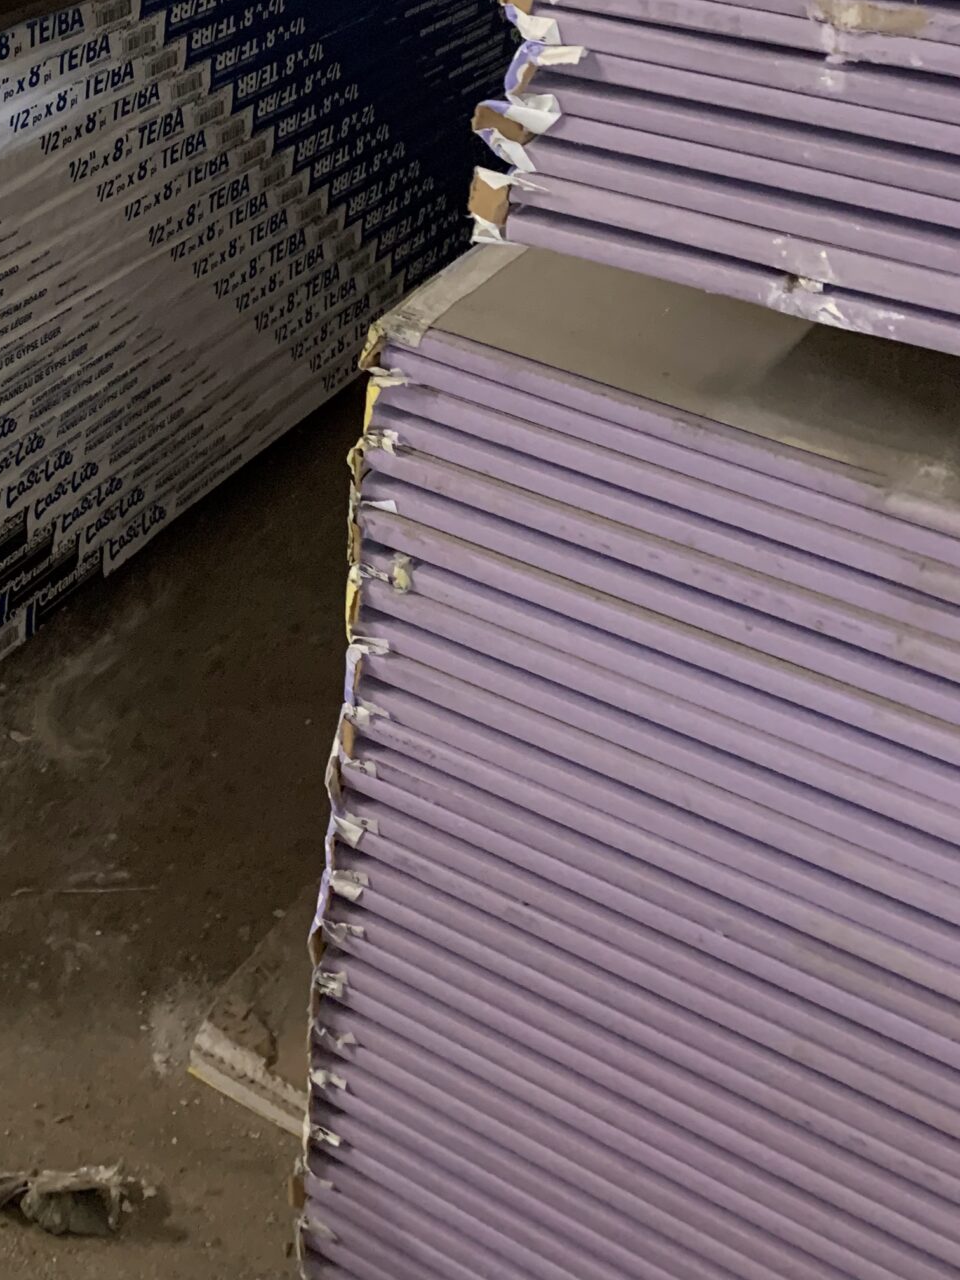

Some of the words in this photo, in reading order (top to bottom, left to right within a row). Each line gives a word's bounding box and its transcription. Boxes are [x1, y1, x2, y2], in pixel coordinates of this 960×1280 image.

[26, 7, 84, 48] TE/BA
[58, 33, 111, 76] TE/BA
[138, 106, 185, 149] TE/BA
[161, 129, 207, 169] TE/BA
[208, 174, 250, 213] TE/BA
